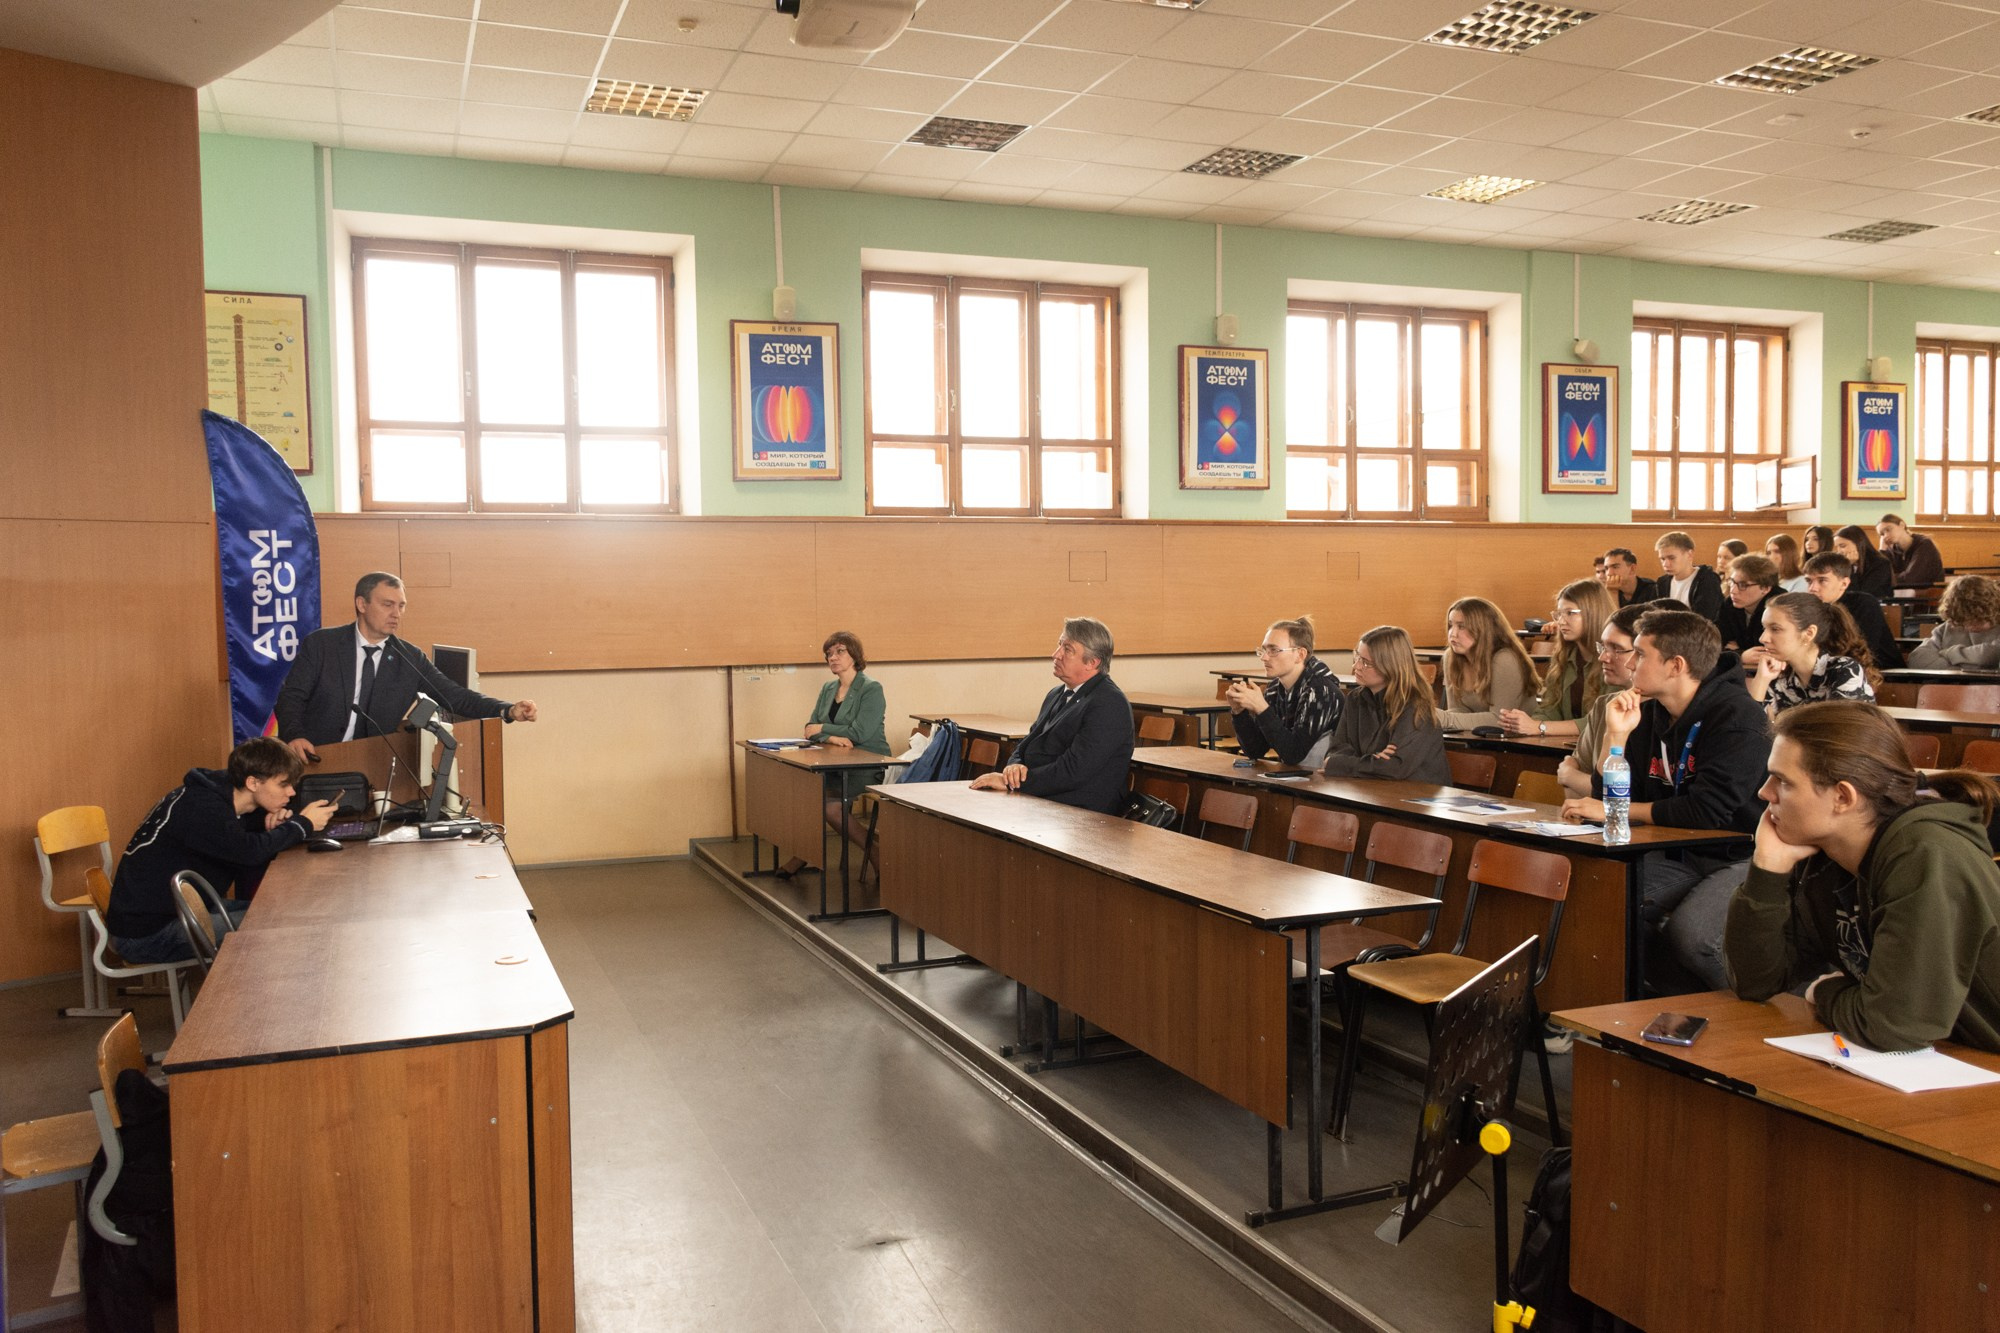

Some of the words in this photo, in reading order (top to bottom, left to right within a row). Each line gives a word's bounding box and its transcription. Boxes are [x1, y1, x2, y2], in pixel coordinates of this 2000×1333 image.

[223, 296, 252, 304] СИЛА
[771, 325, 803, 333] ВРЕМЯ
[1204, 349, 1246, 358] ТЕМПЕРАТУРА
[760, 354, 812, 366] ФЕСТ
[1206, 375, 1247, 386] ФЕСТ
[1564, 391, 1600, 401] ФЕСТ
[1863, 406, 1893, 415] ФЕСТ
[271, 529, 300, 662] ФЕСТ
